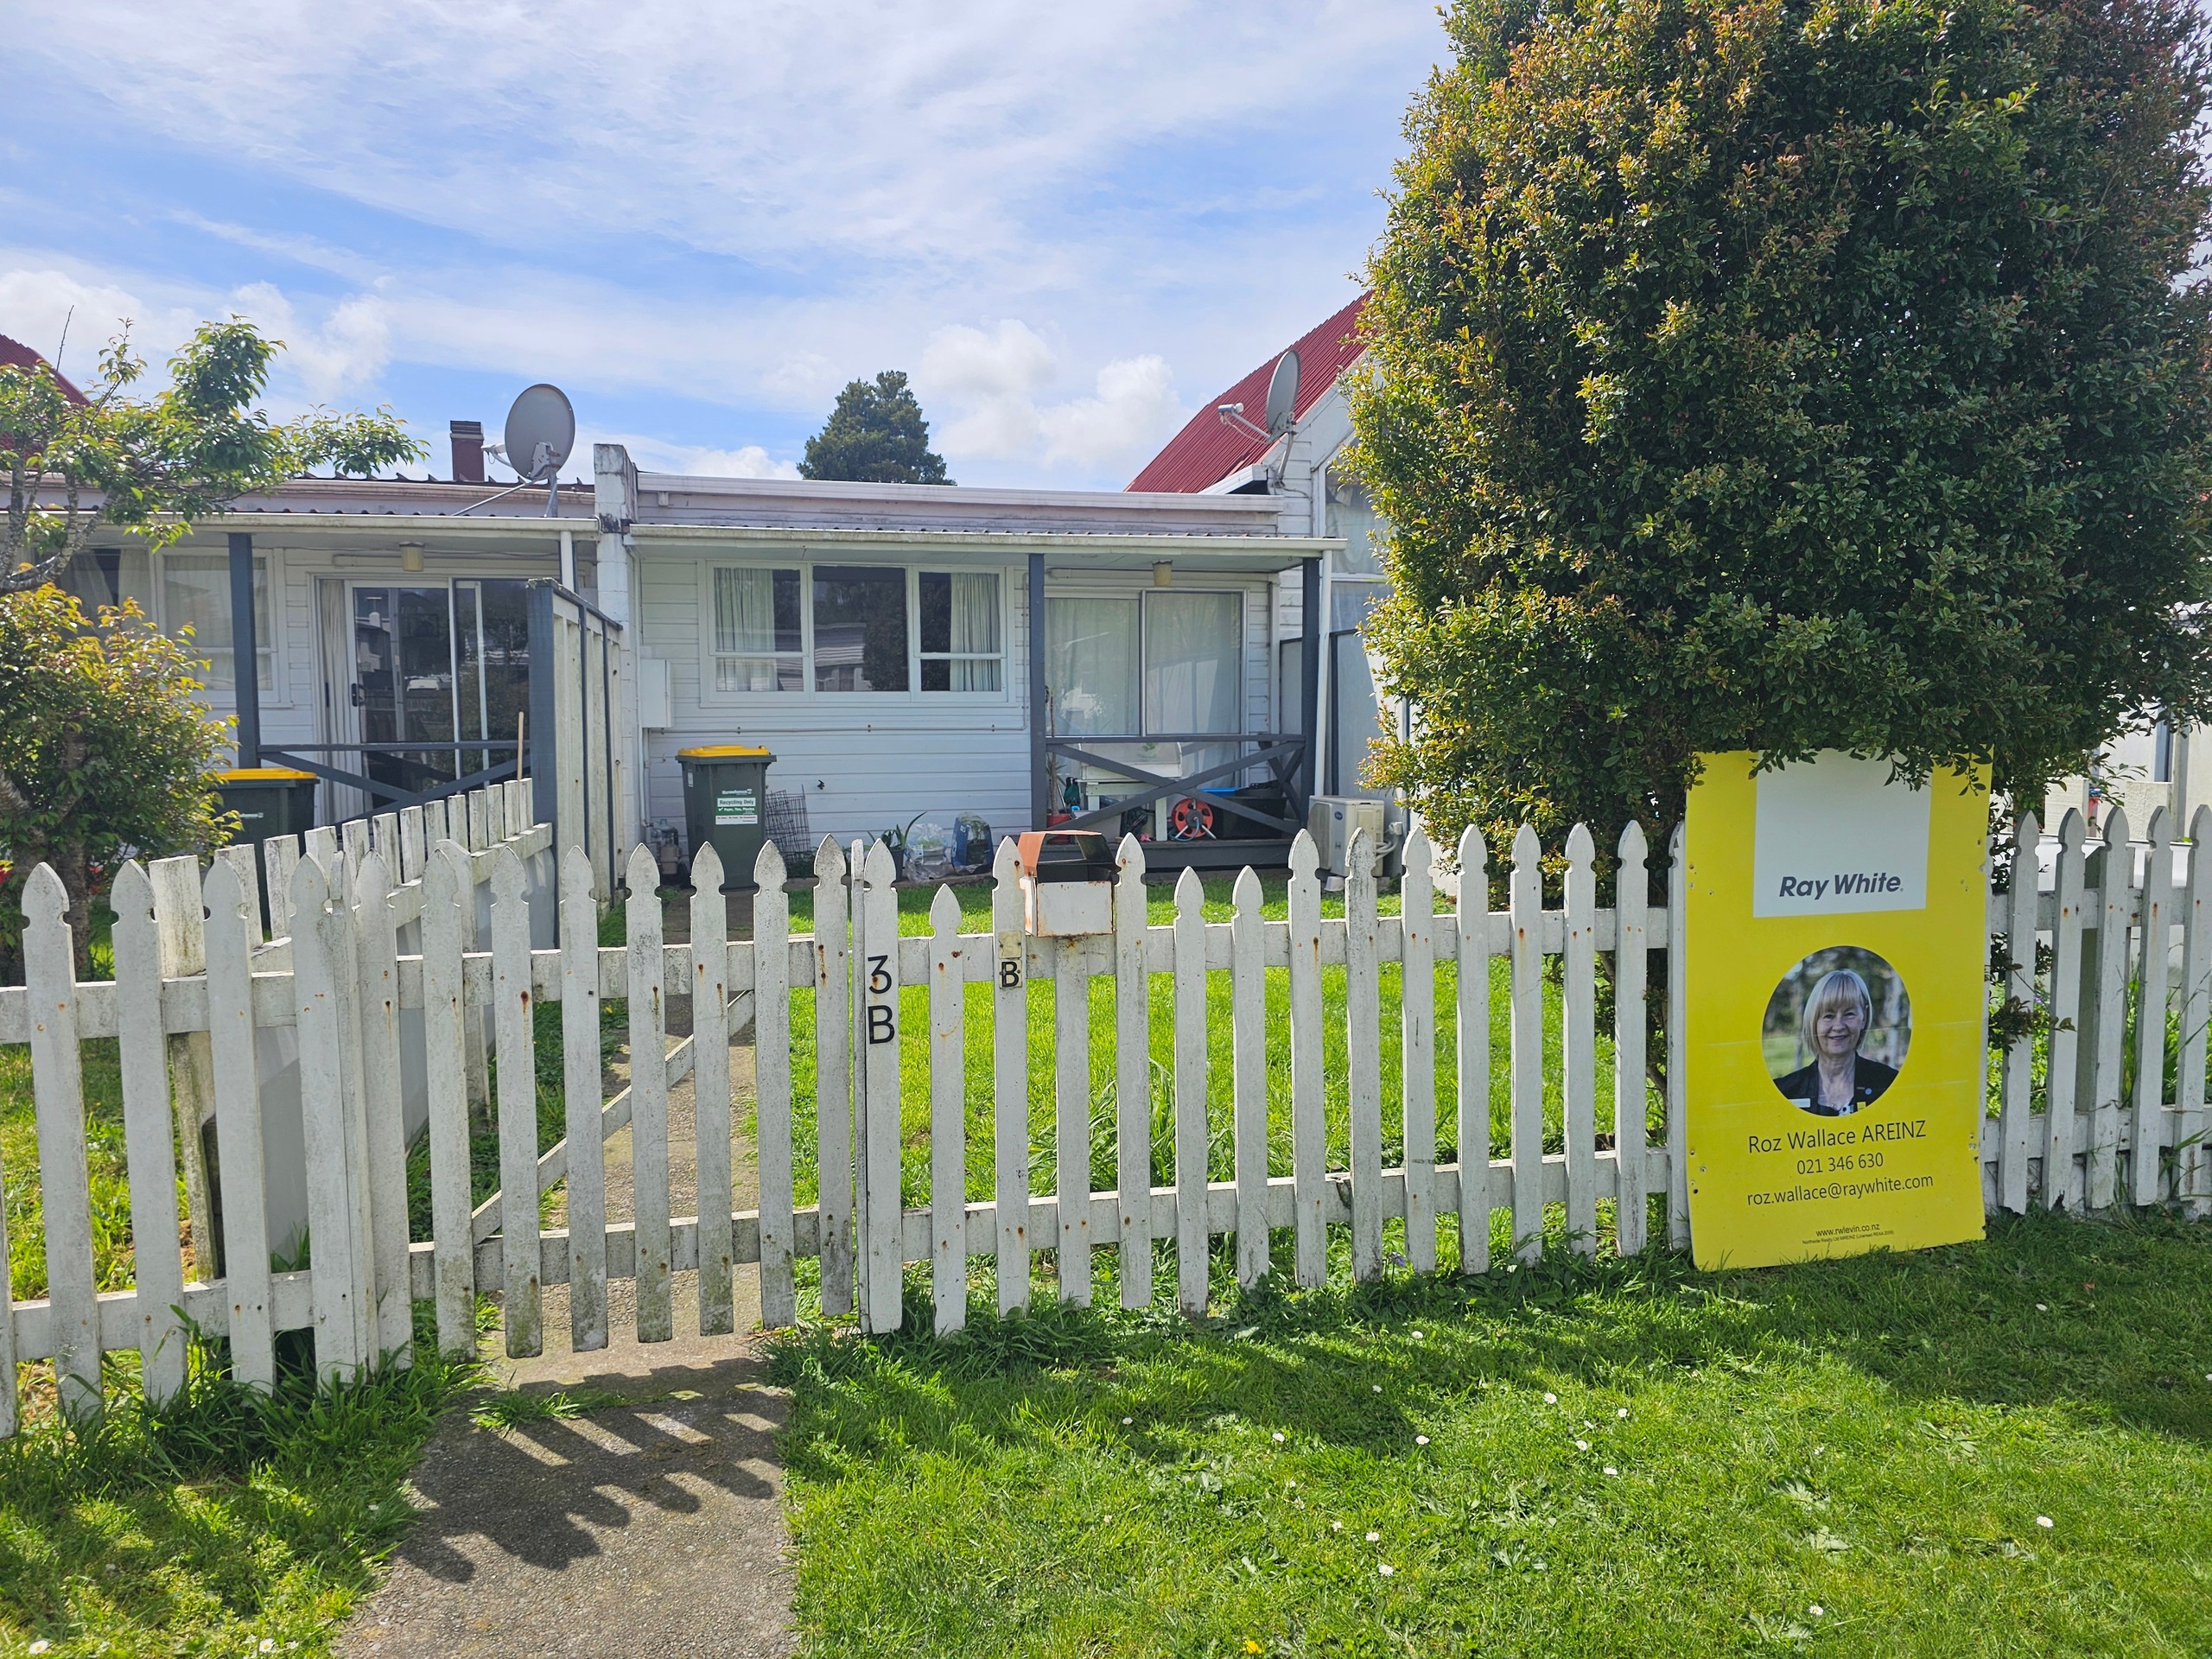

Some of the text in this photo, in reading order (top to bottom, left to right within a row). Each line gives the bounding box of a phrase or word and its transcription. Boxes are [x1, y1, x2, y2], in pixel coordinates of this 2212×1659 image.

[1778, 872, 1902, 900] Ray White
[1001, 961, 1020, 988] B
[867, 954, 895, 1046] 3 B
[1748, 1120, 1927, 1154] Roz Wallace AREINZ
[1796, 1152, 1884, 1175] 021 346 630
[1747, 1175, 1934, 1205] roz.wallace@raywhite.com
[1815, 1223, 1880, 1237] www.rwlevin.co.nz
